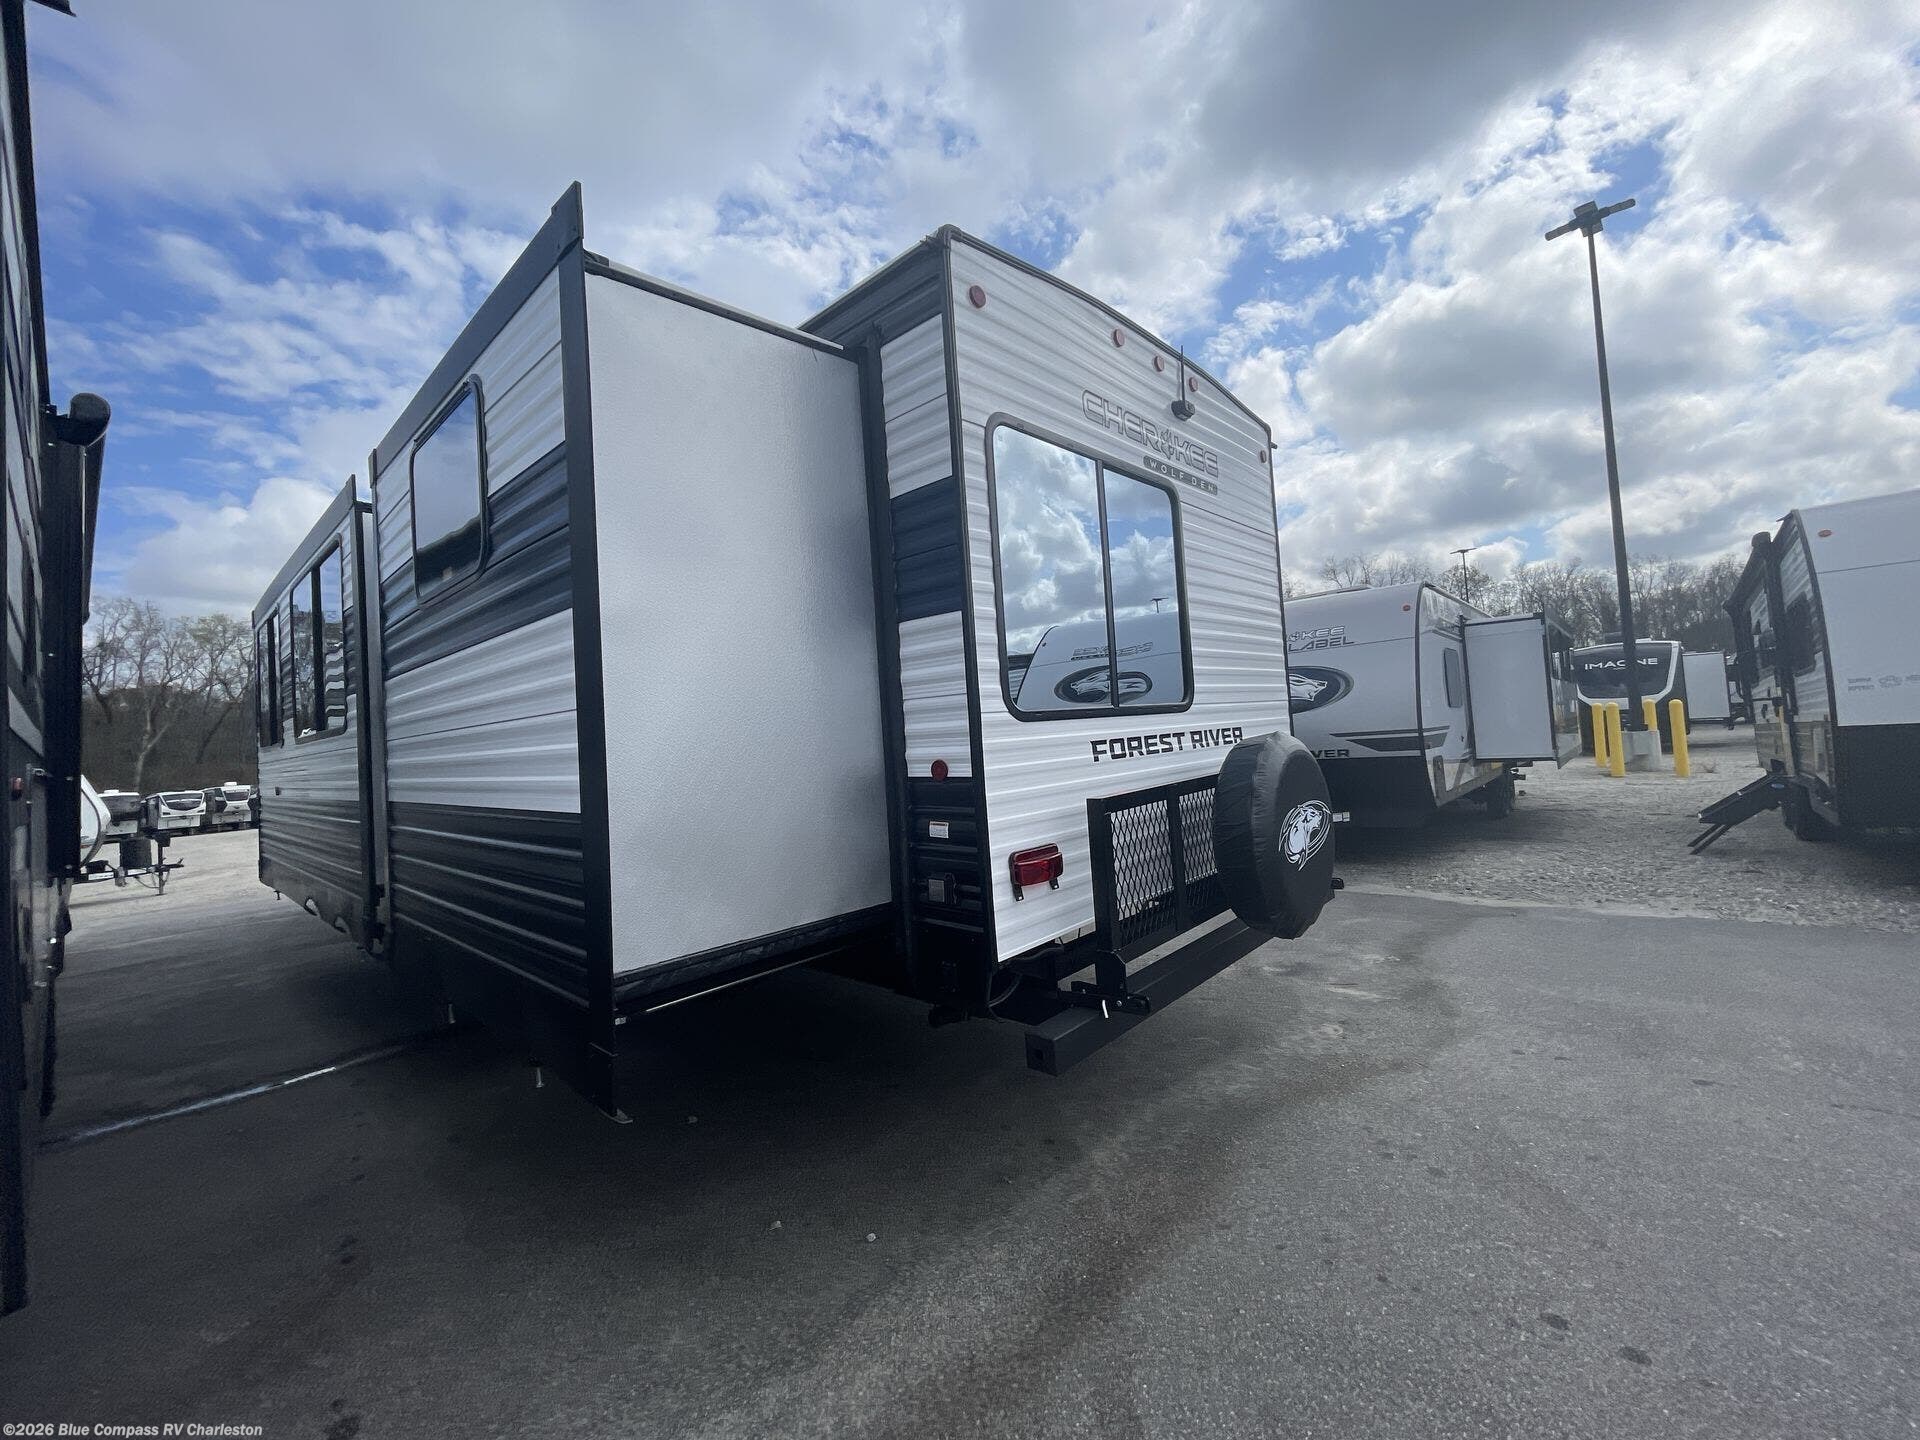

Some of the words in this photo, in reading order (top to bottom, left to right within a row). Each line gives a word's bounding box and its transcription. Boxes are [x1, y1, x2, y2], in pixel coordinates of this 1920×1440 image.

[1149, 459, 1184, 479] WOLF
[1288, 636, 1354, 652] LABEL
[1090, 732, 1185, 762] FOREST
[1189, 726, 1243, 750] RIVER
